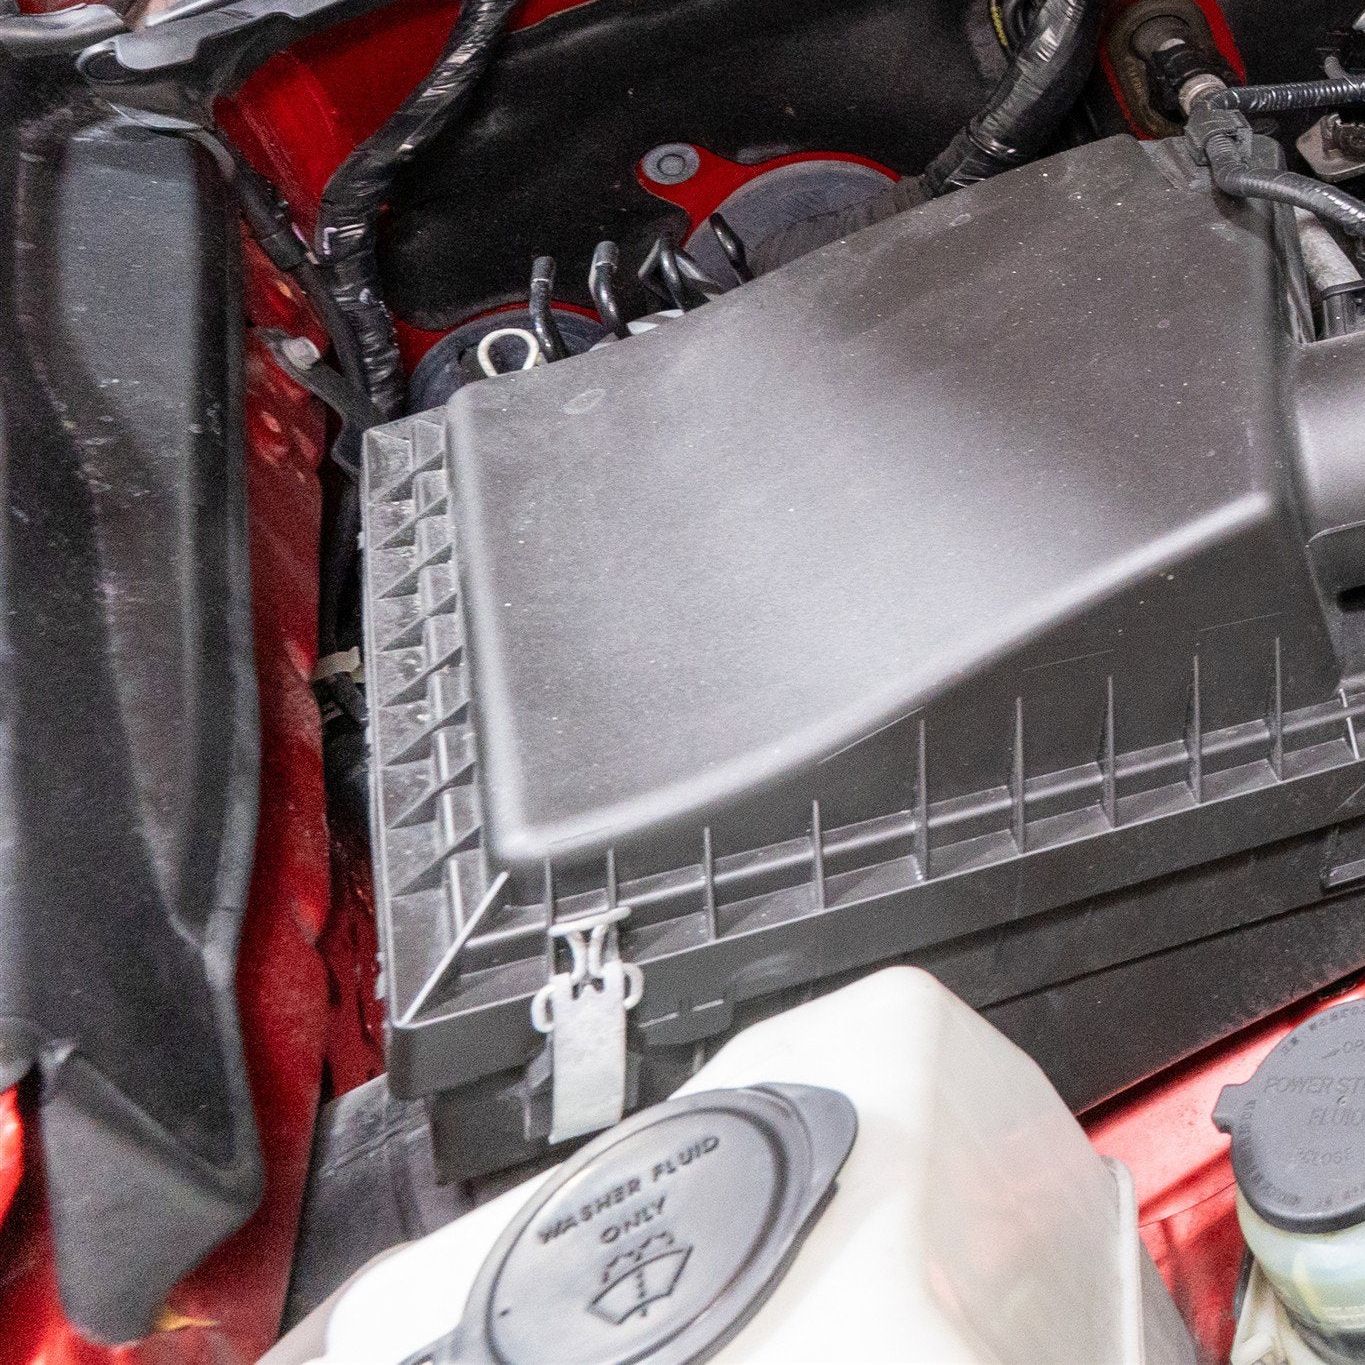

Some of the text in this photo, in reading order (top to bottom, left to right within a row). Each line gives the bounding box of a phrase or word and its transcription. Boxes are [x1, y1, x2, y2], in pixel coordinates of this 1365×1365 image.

[1263, 1075, 1331, 1096] POWER
[537, 1135, 720, 1244] WASHER FLUID
[600, 1194, 667, 1245] ONLY
